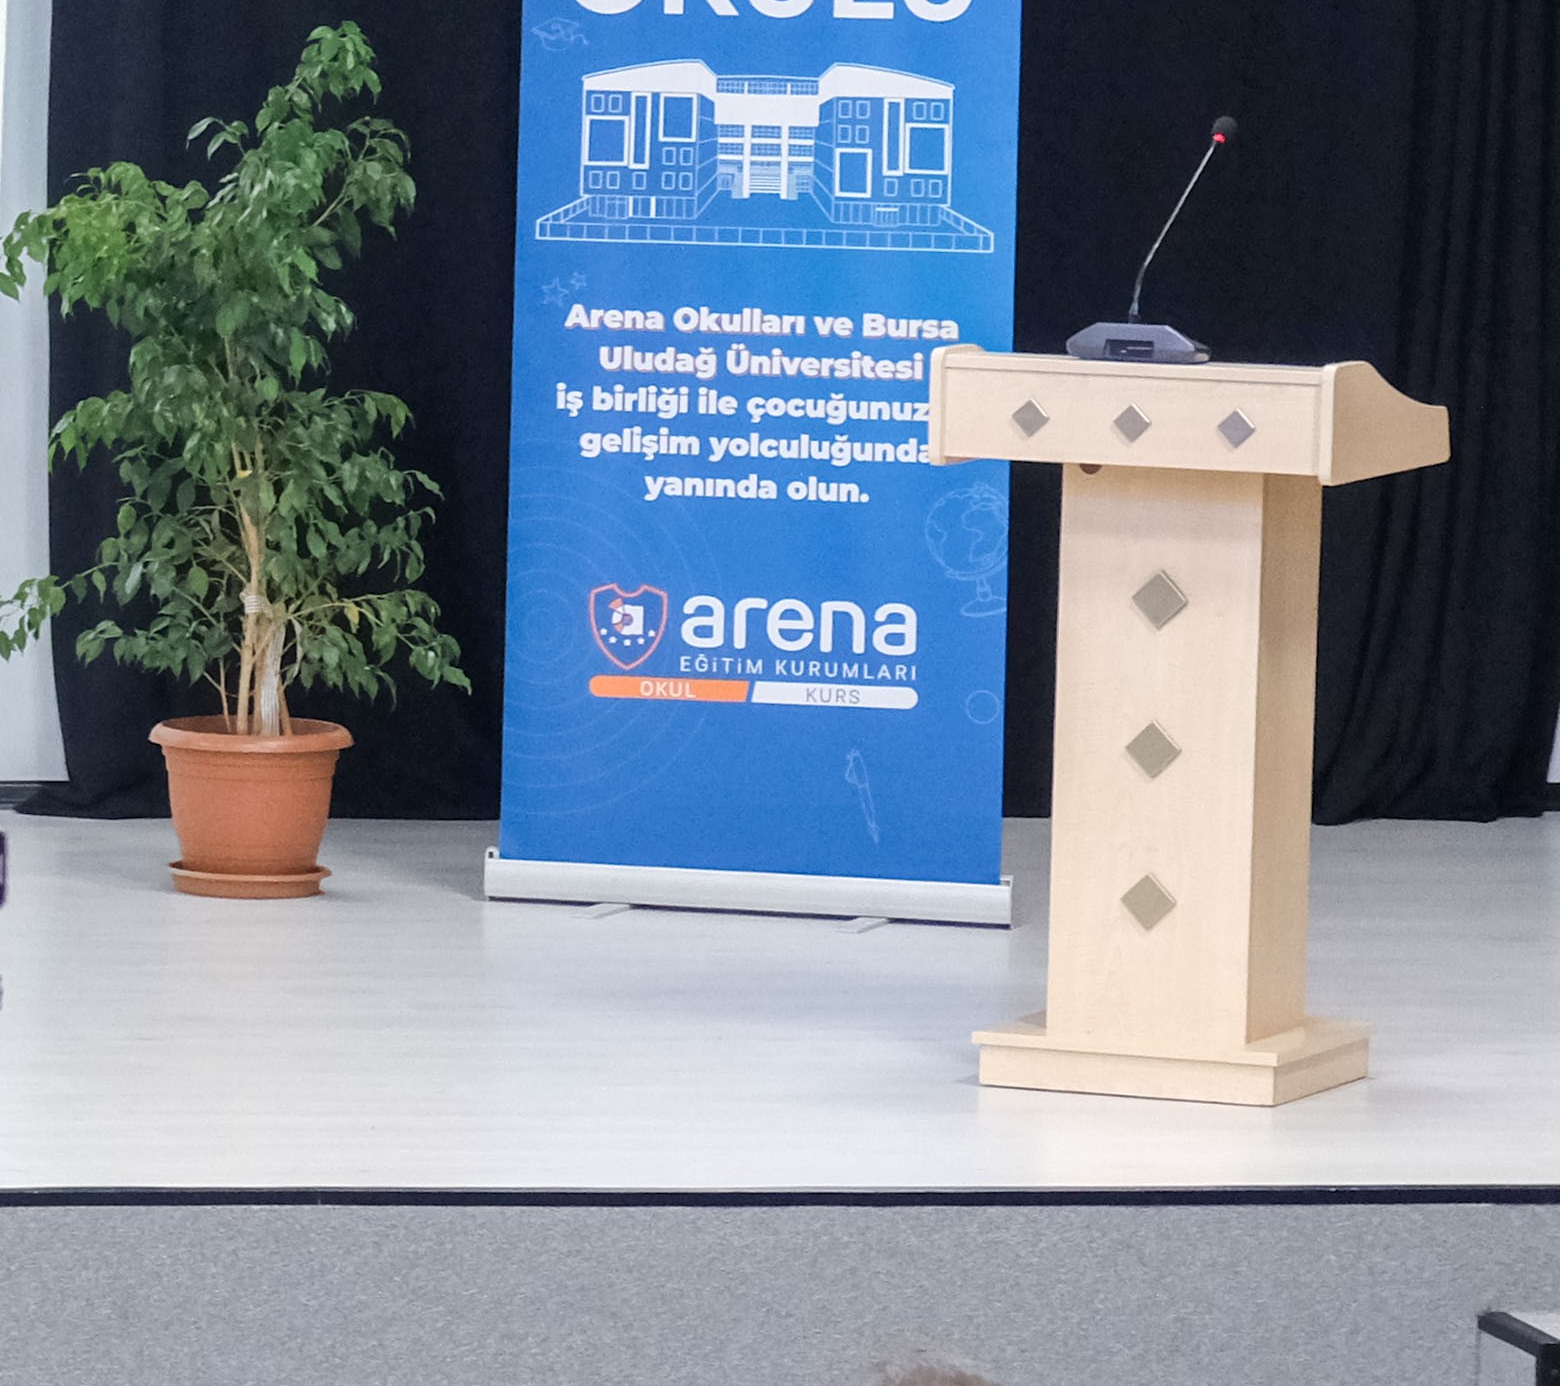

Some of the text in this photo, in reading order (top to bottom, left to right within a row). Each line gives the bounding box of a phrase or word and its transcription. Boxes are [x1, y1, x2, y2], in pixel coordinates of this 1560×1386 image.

[565, 304, 958, 339] Arena Okulları ve Bursa
[600, 344, 923, 380] Uludağ Üniversitesi
[557, 383, 929, 425] iş birliği ile çocuğunuz
[580, 426, 699, 460] gelişim
[645, 474, 869, 502] yanında olun.
[681, 596, 917, 655] arena
[775, 660, 916, 681] KURUMLARI
[640, 680, 696, 698] OKUL
[806, 688, 861, 705] KURS
